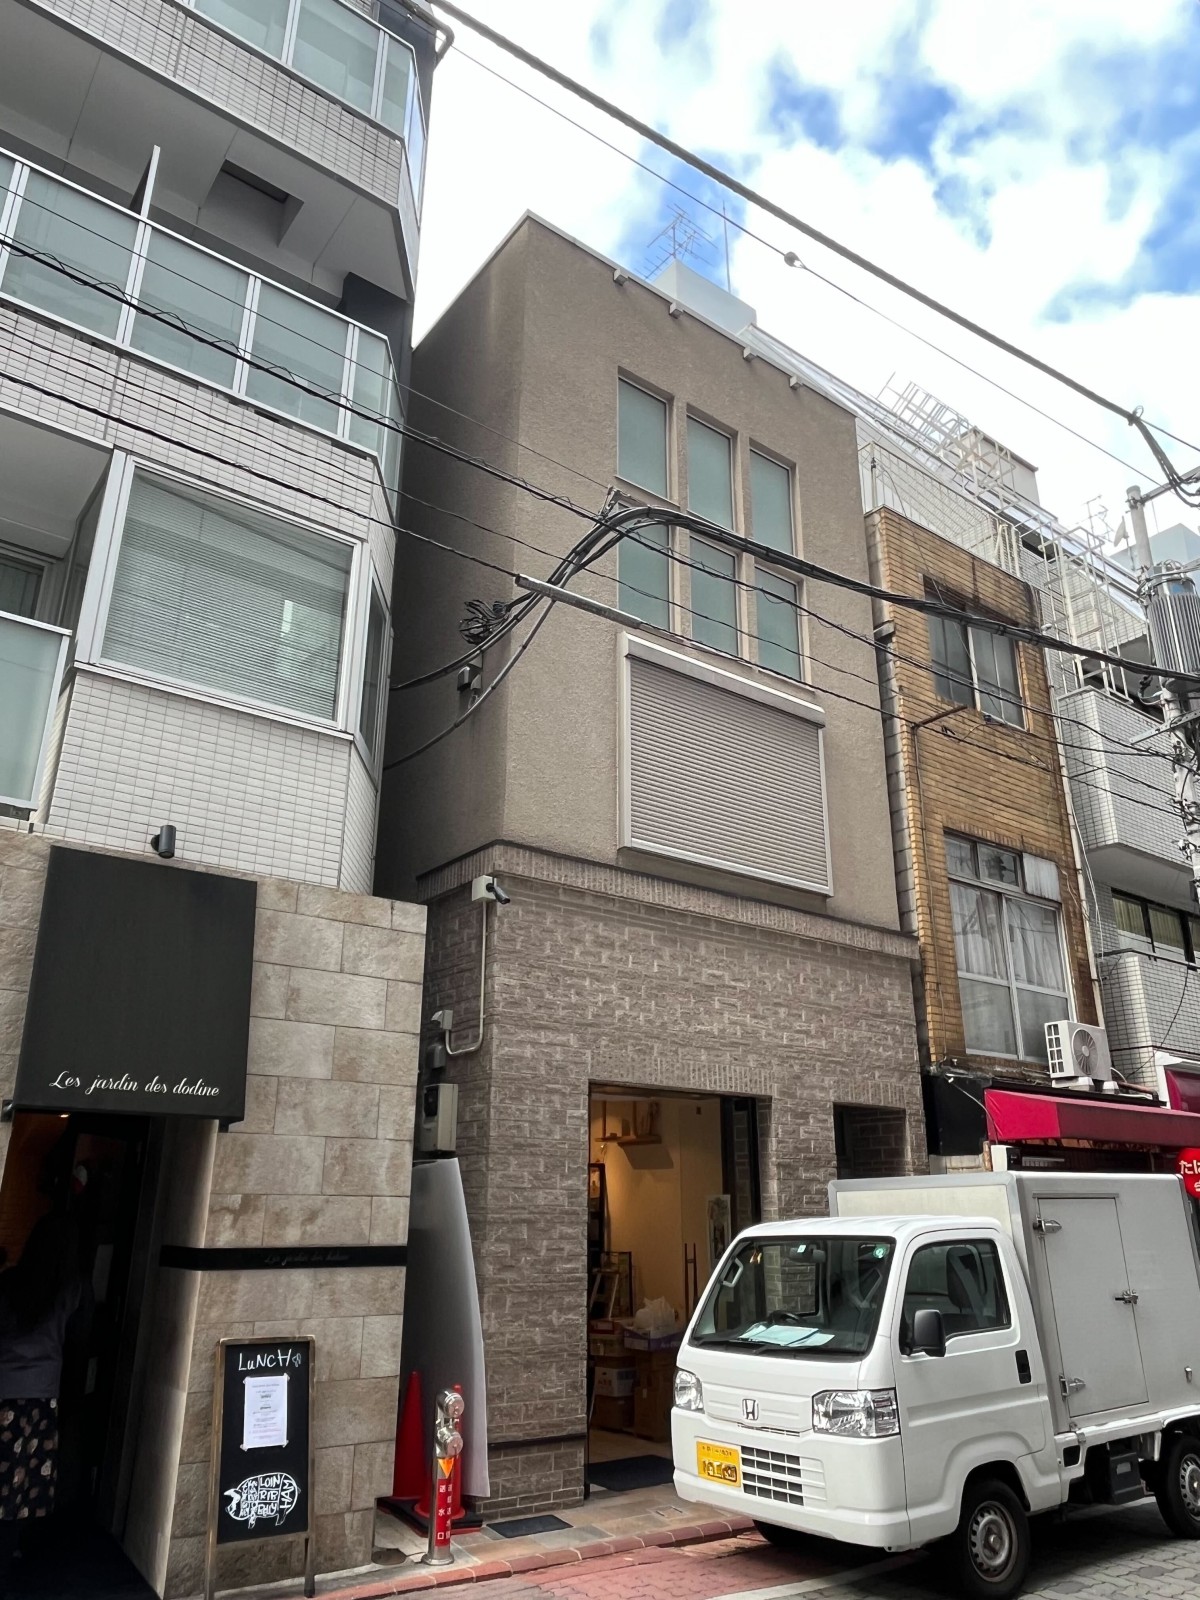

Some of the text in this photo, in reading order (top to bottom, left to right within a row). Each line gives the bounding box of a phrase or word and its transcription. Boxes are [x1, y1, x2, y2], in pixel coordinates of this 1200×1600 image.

[49, 1070, 220, 1097] Les jardin des dodine
